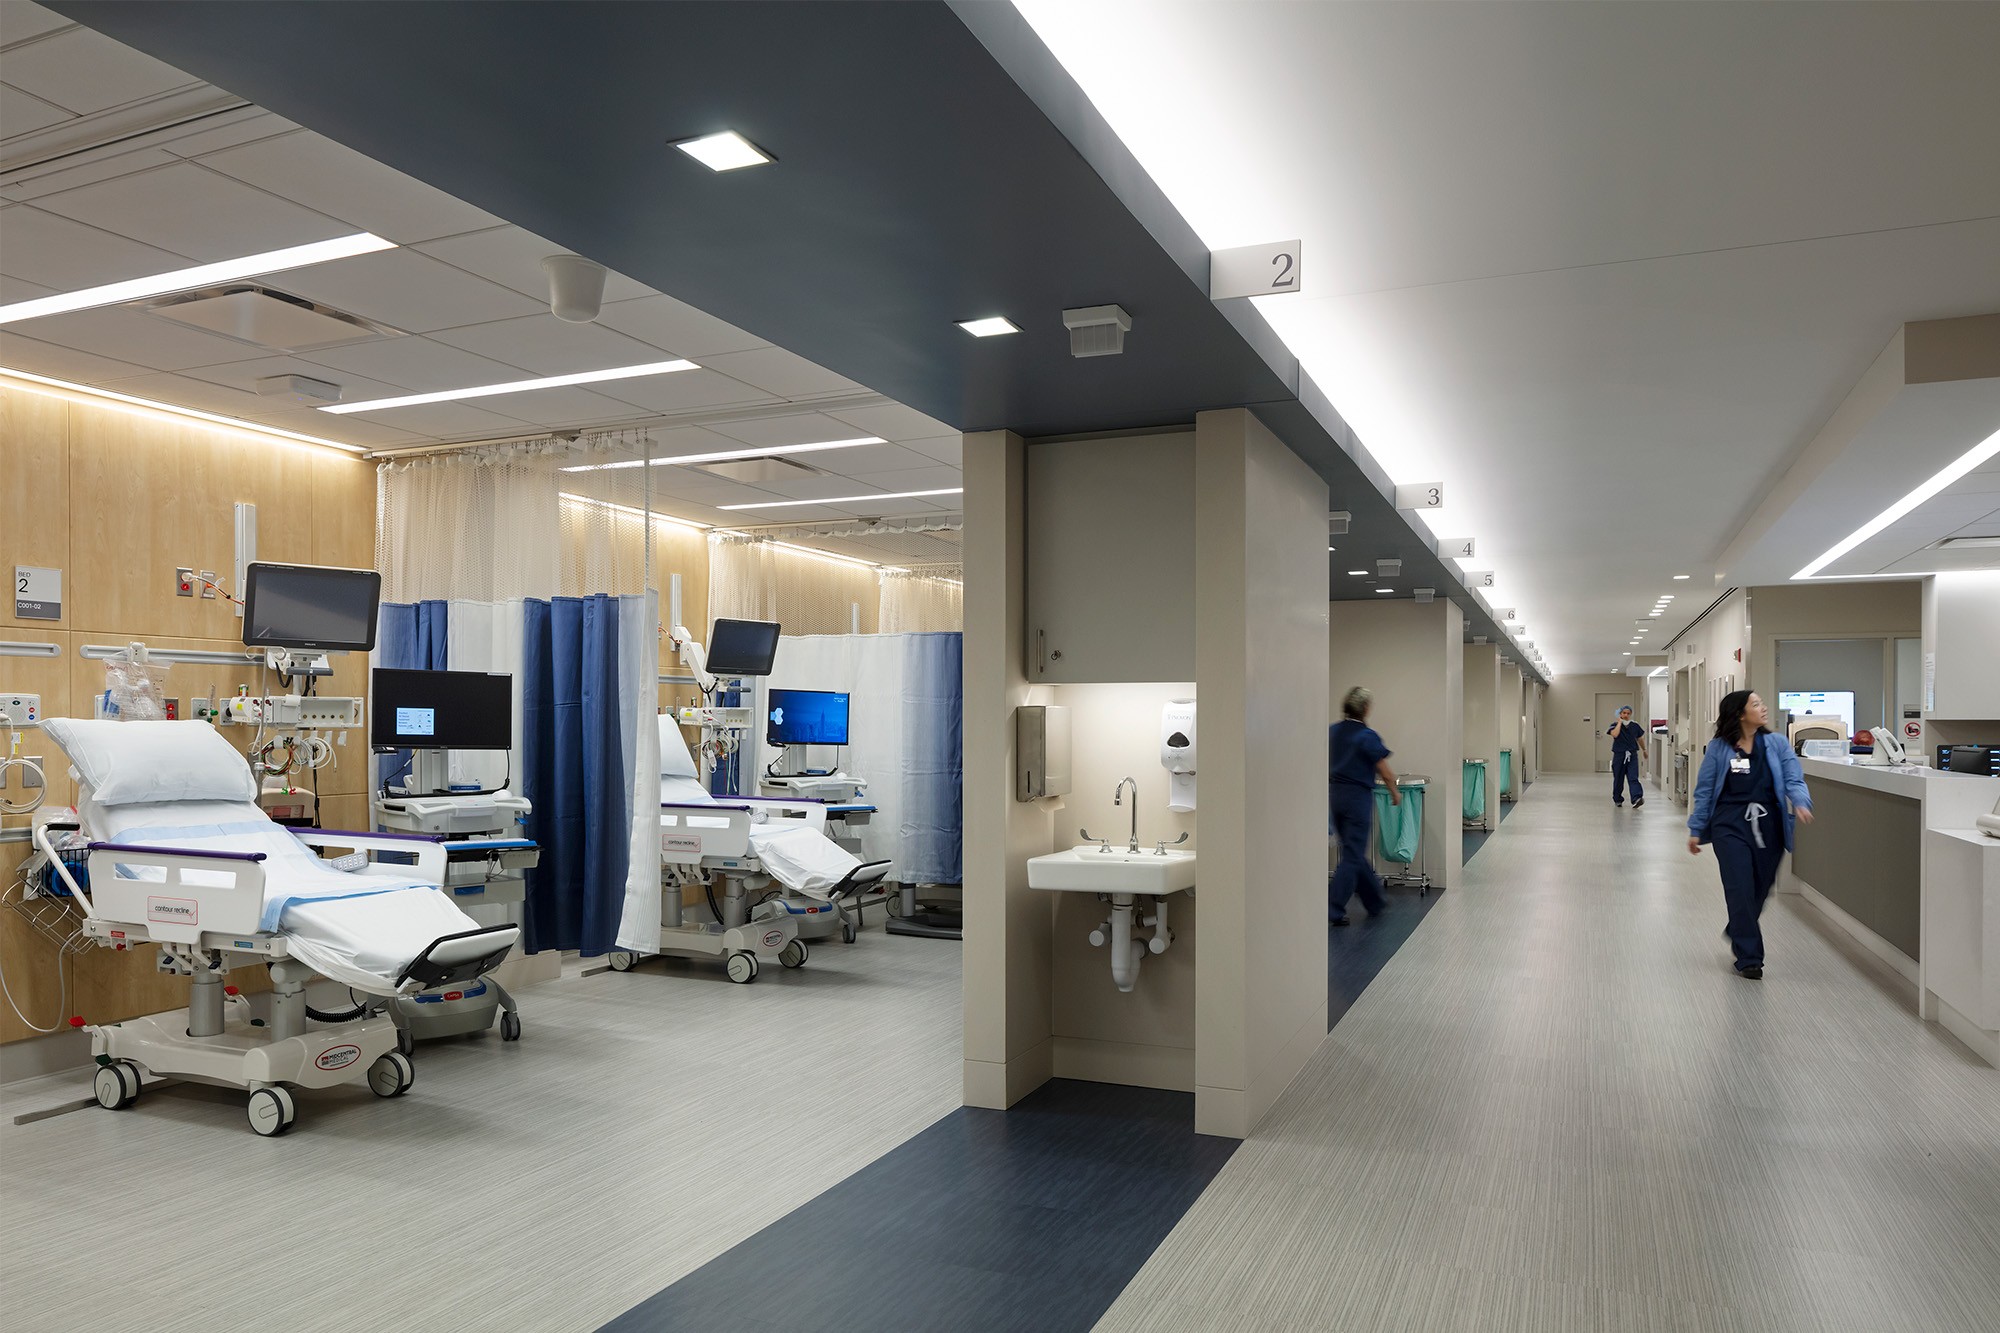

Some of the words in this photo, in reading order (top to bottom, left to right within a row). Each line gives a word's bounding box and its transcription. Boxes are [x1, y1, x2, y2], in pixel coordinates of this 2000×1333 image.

[1271, 253, 1294, 288] 2
[1428, 488, 1440, 506] 3
[1462, 542, 1472, 556] 4
[18, 578, 29, 593] 2
[1484, 574, 1493, 586] 5
[1508, 610, 1514, 619] 6
